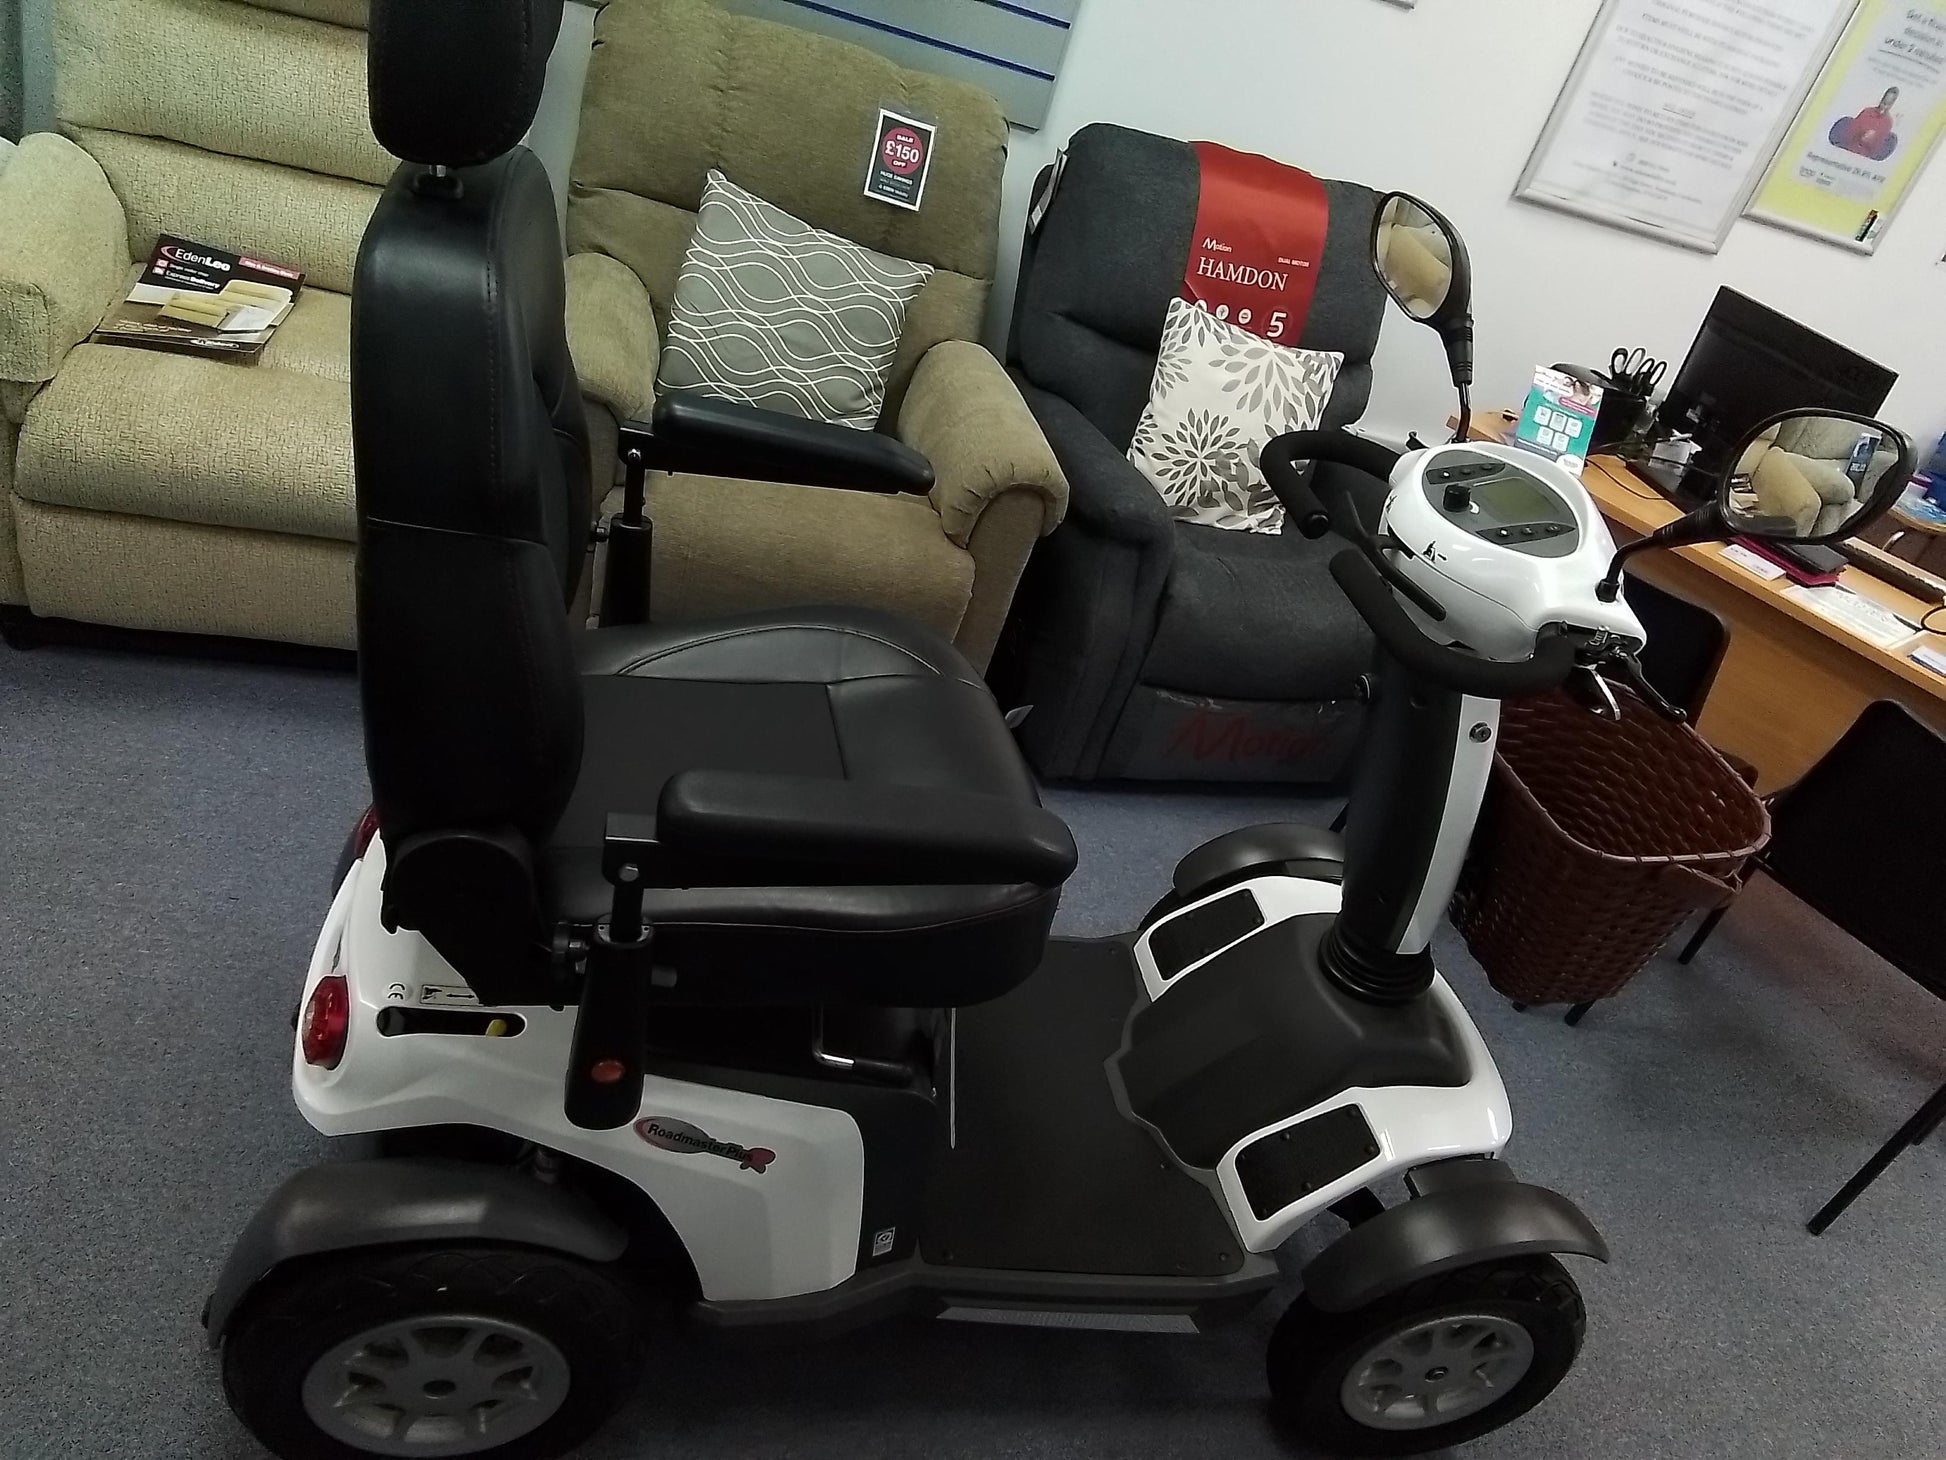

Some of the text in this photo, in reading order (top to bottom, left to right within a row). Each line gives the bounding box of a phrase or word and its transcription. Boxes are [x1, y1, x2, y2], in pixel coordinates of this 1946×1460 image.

[884, 140, 920, 163] £150
[1202, 236, 1232, 253] Motion
[174, 248, 231, 272] EdenLeo
[1196, 256, 1288, 291] HAMDON
[1266, 311, 1288, 338] 5
